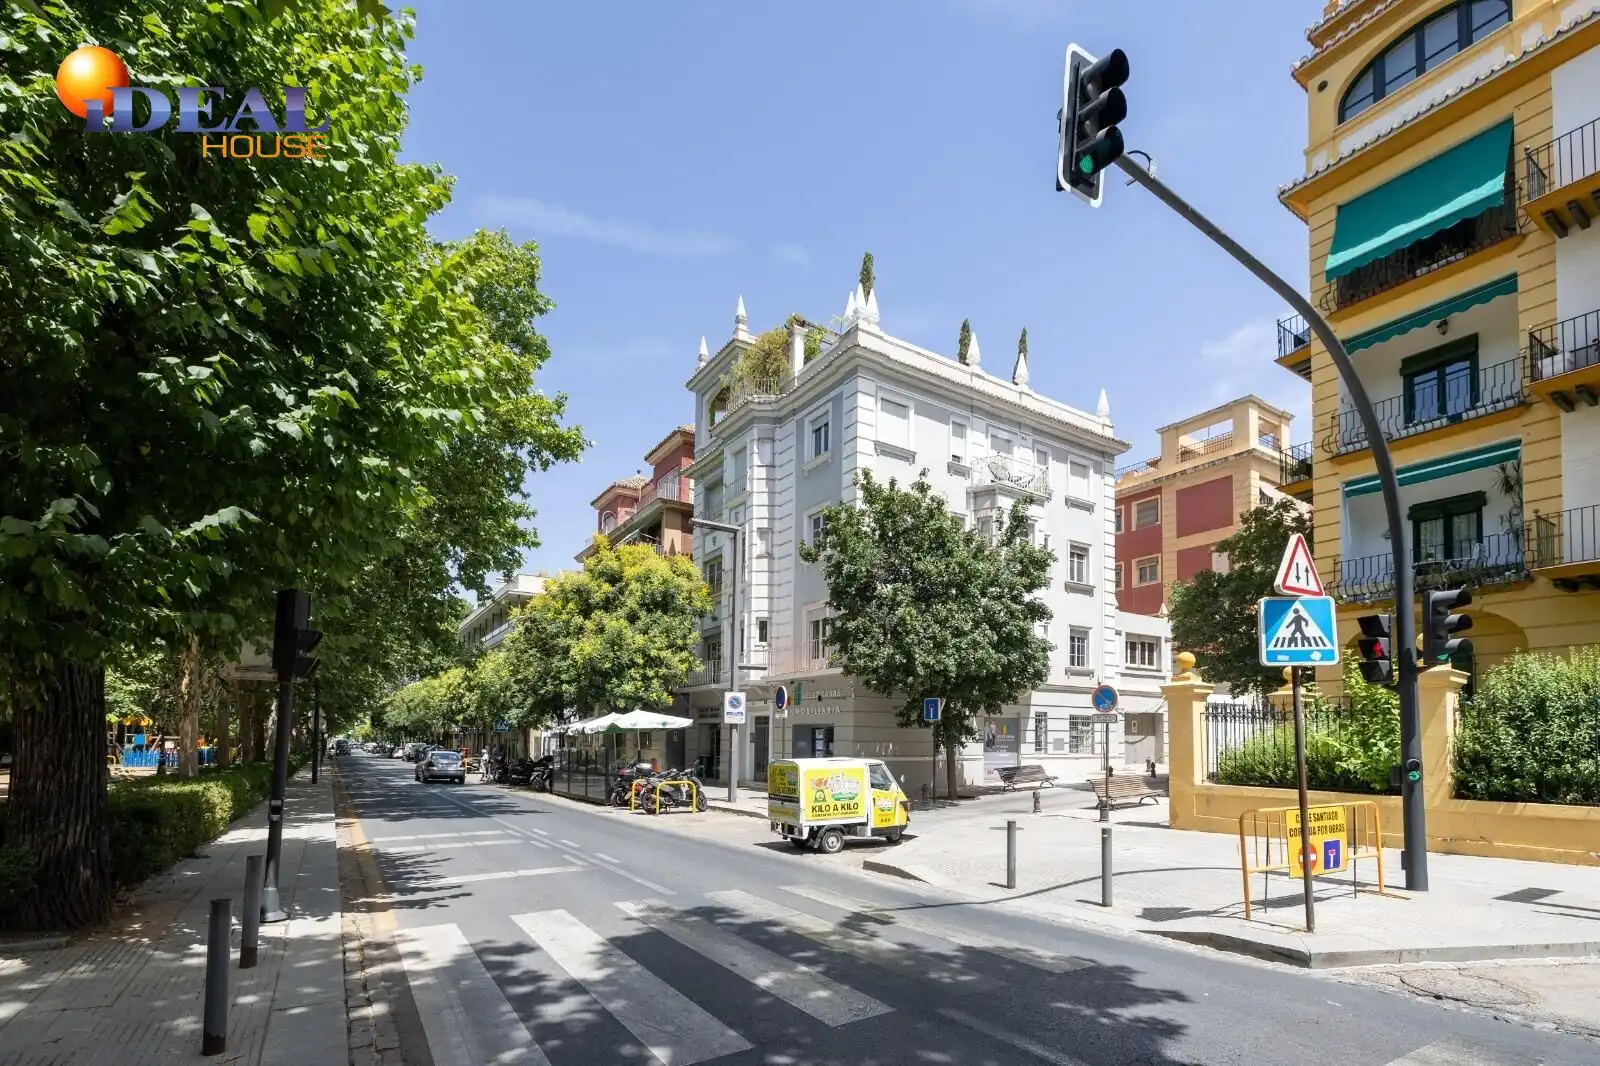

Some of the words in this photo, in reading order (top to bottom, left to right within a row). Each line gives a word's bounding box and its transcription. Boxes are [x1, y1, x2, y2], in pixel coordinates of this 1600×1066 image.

[811, 804, 831, 813] KILO
[833, 803, 839, 812] A
[840, 802, 859, 811] KILO
[1312, 811, 1338, 822] SANTIAGO
[1289, 826, 1317, 837] CORDA
[1318, 825, 1328, 836] POR
[1329, 823, 1345, 834] OBRAS
